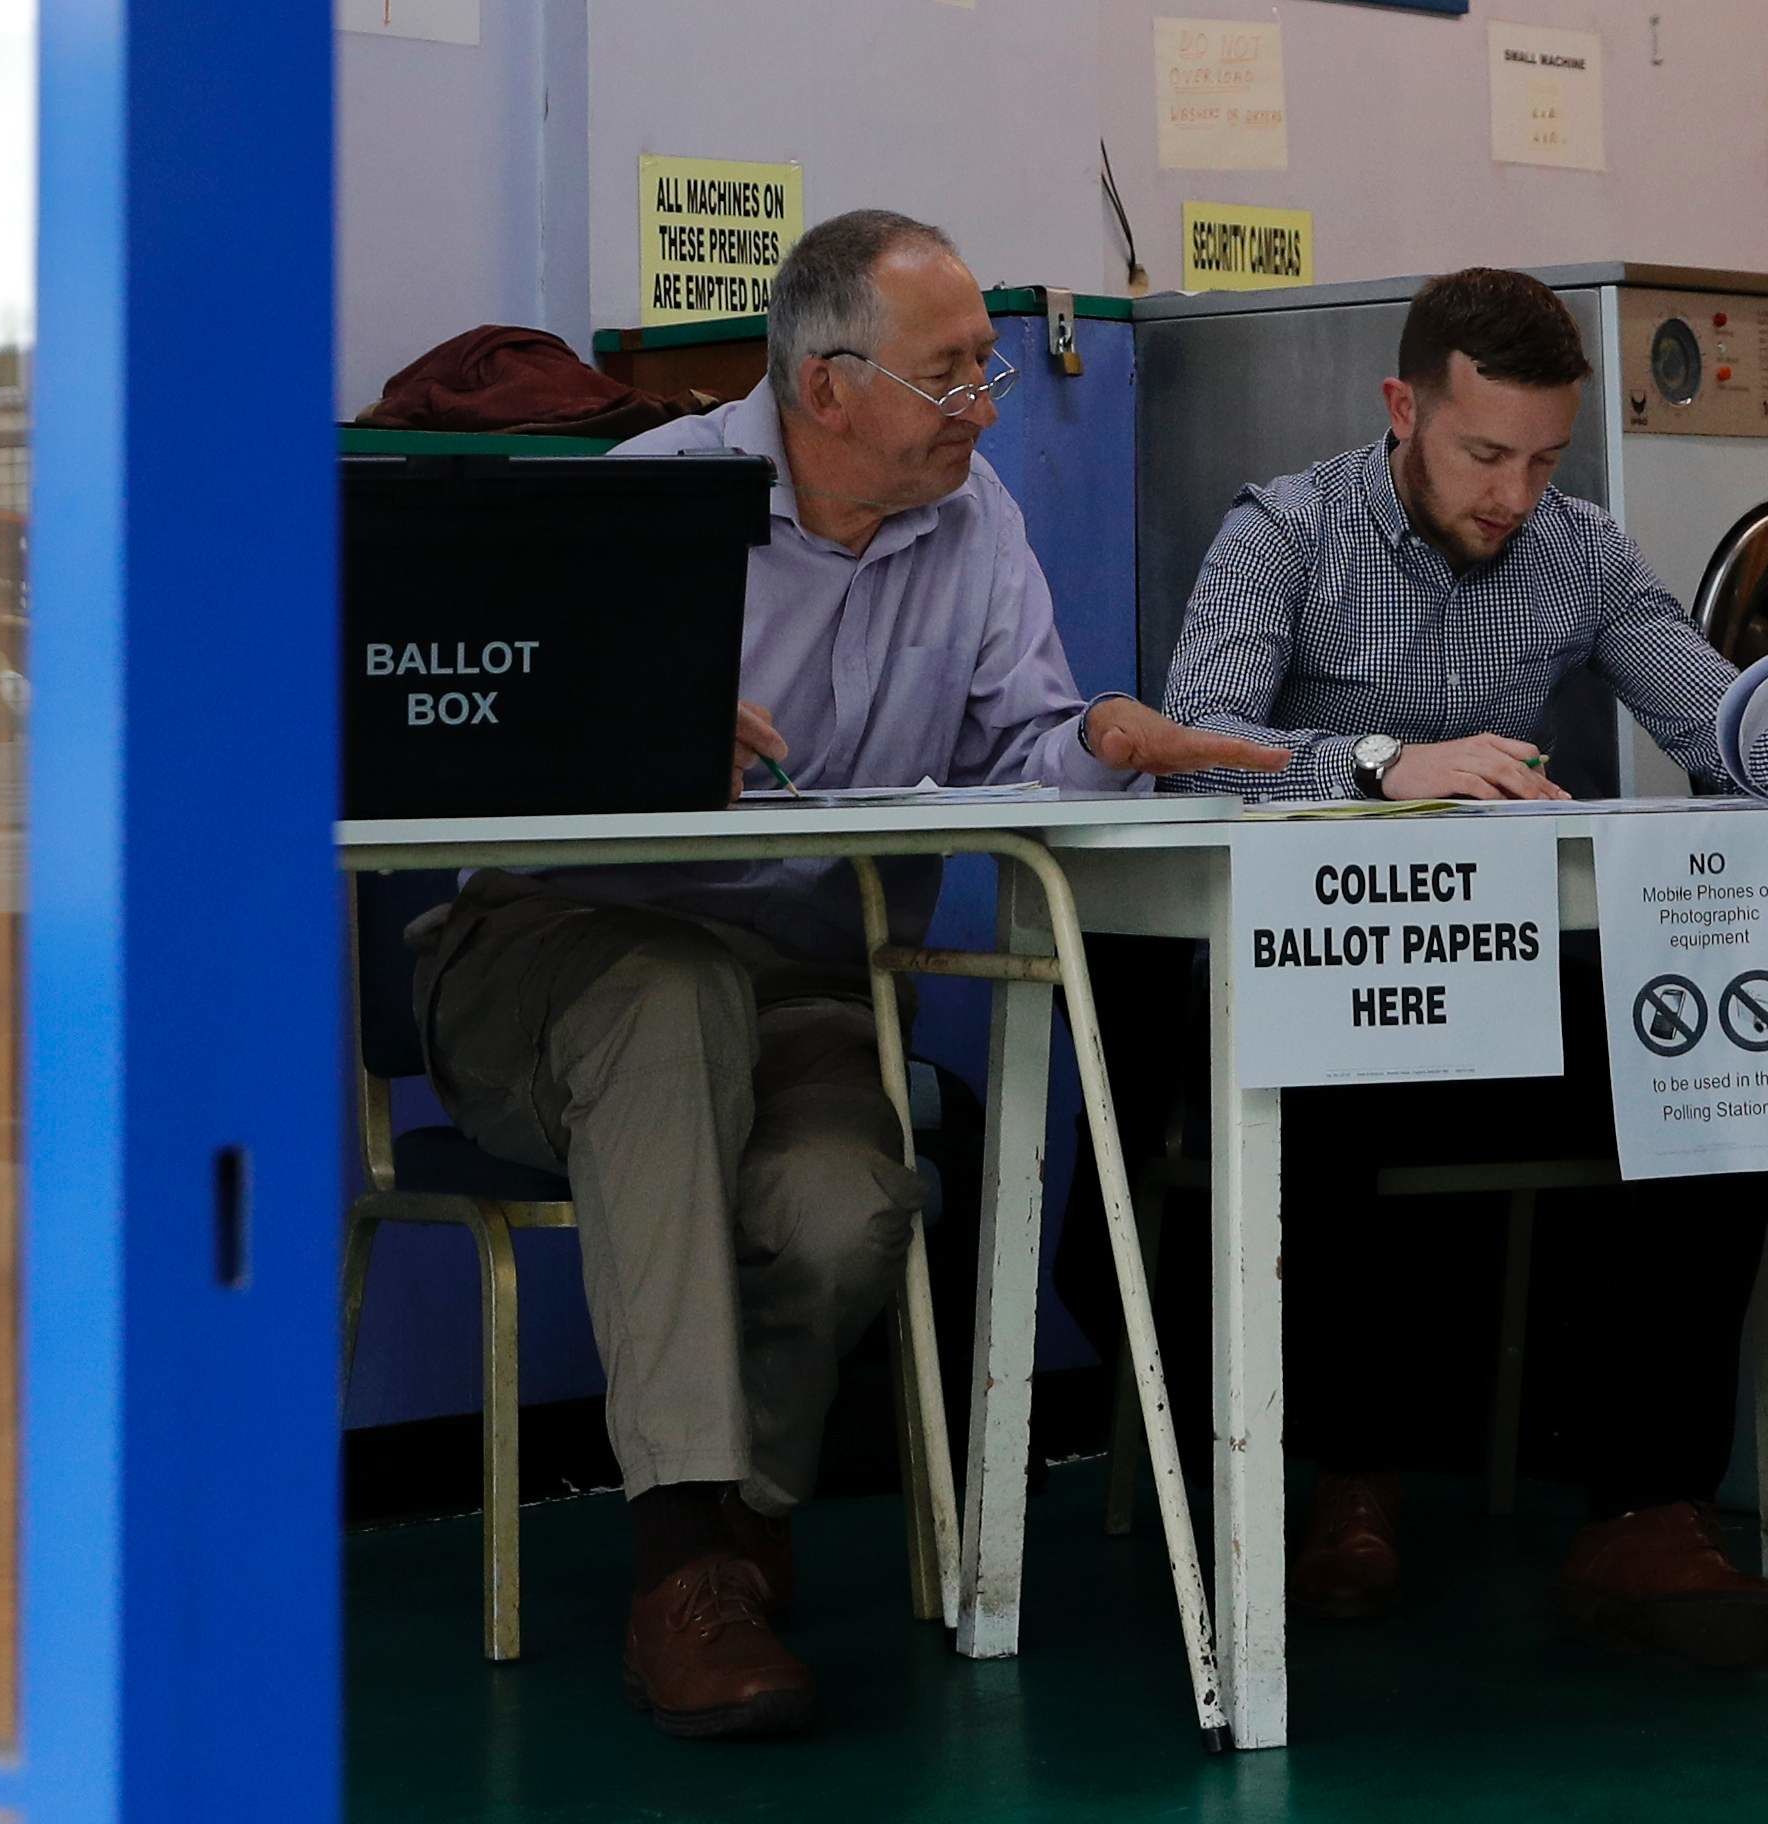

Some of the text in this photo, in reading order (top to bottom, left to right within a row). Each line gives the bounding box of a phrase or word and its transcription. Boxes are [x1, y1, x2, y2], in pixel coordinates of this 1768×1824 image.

[1504, 48, 1586, 71] SMALL MACHINE
[656, 176, 785, 219] ALL MACHINES ON
[659, 225, 780, 266] THESE PREMISES
[1192, 219, 1301, 277] SECURITY CAMERAS
[653, 273, 682, 310] ARE
[686, 274, 748, 312] EMPTIED
[366, 640, 540, 676] BALLOT
[407, 691, 500, 726] BOX
[1689, 852, 1726, 876] NO
[1315, 862, 1477, 906] COLLECT
[1642, 886, 1693, 903] Mobile
[1697, 884, 1754, 901] Phones
[1659, 905, 1761, 927] Photographic
[1253, 921, 1540, 968] BALLOT PAPERS
[1670, 929, 1750, 950] equipment
[1352, 985, 1447, 1027] HERE
[1653, 1077, 1666, 1093] to
[1671, 1075, 1689, 1092] be
[1693, 1072, 1731, 1090] used
[1736, 1072, 1750, 1087] in
[1663, 1102, 1712, 1122] Polling
